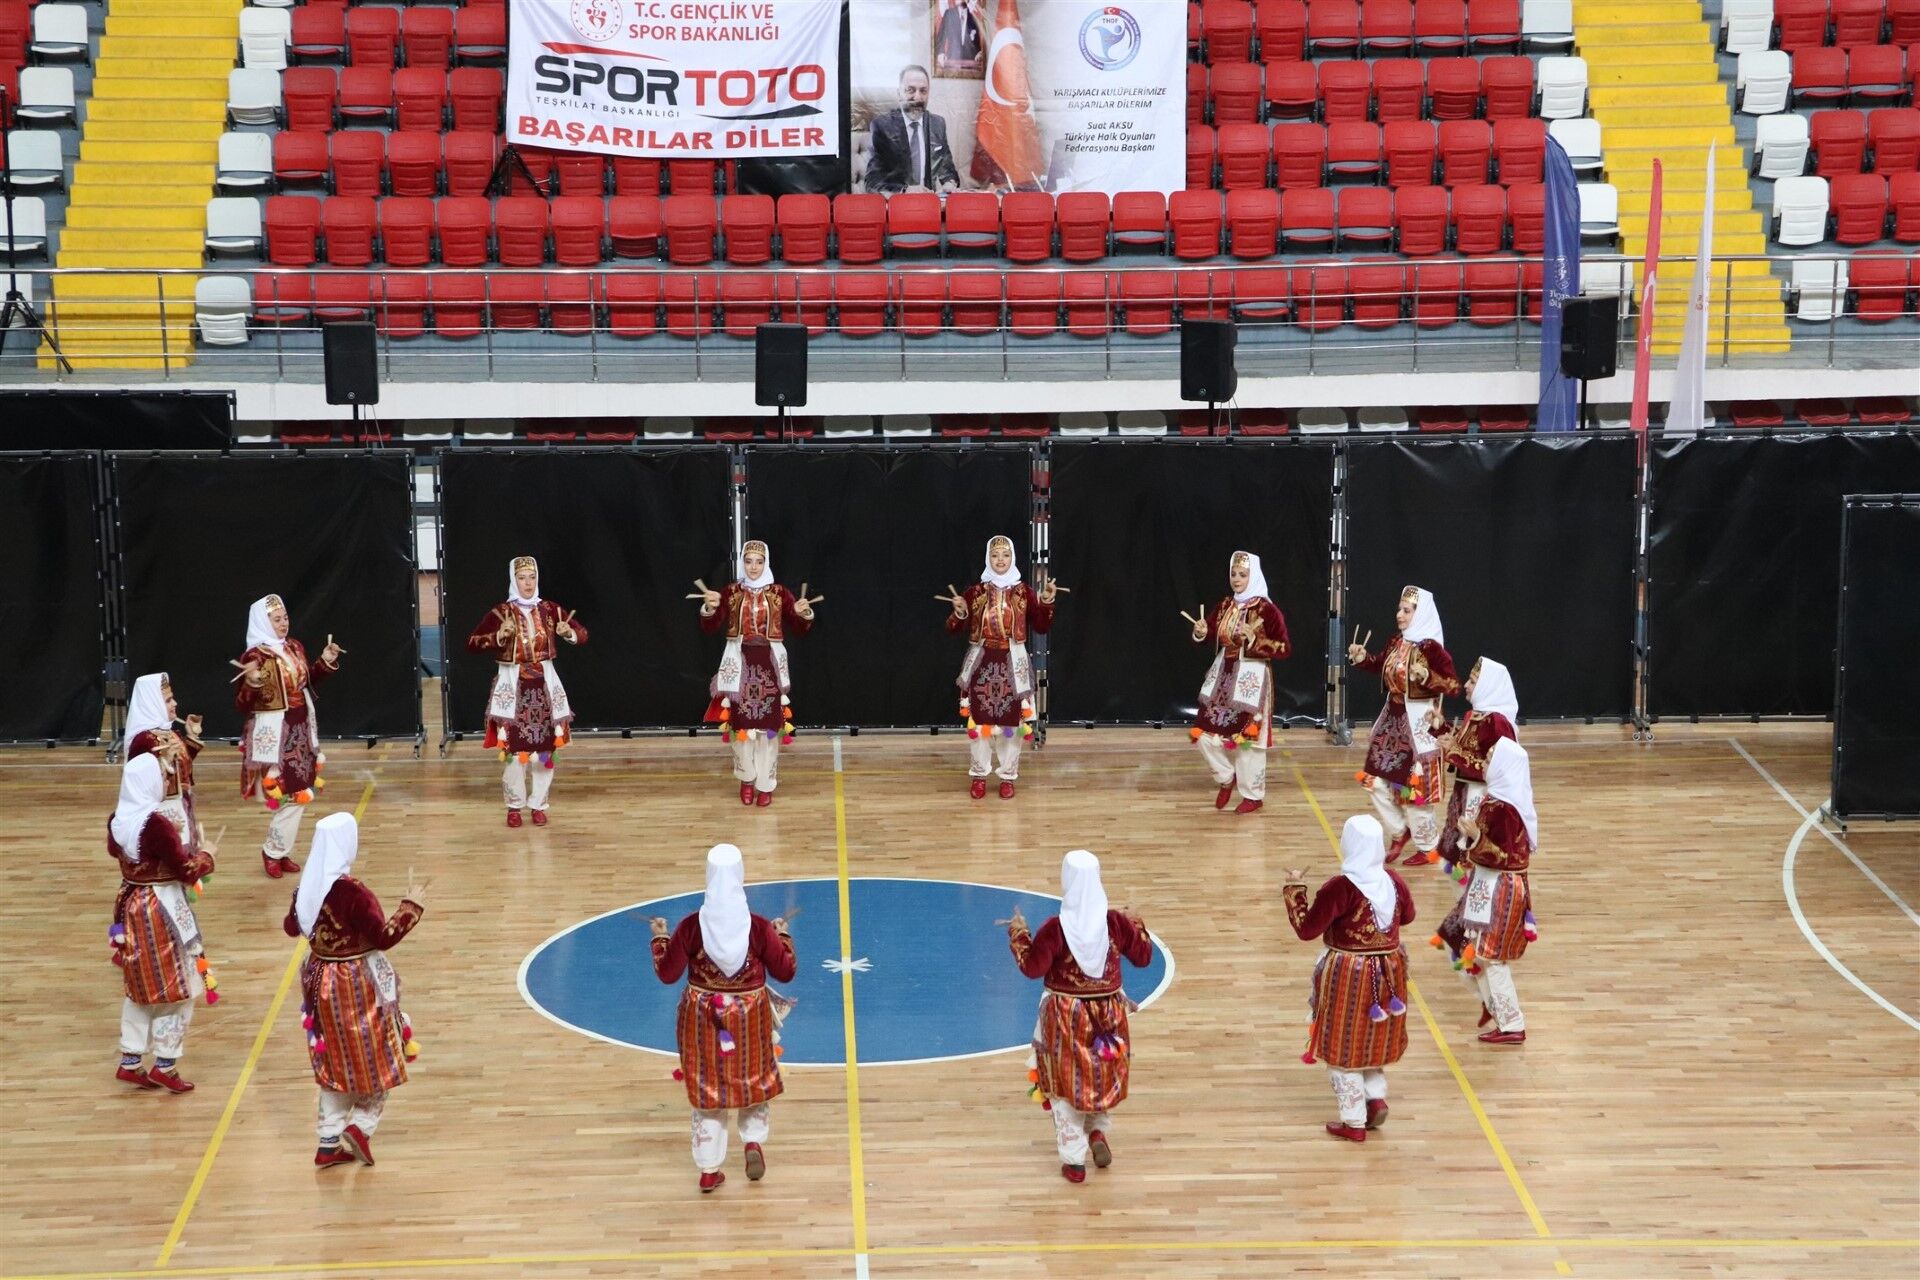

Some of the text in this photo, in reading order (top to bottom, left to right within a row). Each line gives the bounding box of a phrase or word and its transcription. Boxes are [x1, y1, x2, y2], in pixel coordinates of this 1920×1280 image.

[634, 2, 774, 24] T.C. GENÇLİK VE
[629, 22, 779, 42] SPOR BAKANLIĞI
[534, 54, 826, 107] SPOR TOTO
[1053, 86, 1167, 98] YARIŞMACI KULÜPLERİMİZE
[535, 96, 680, 119] TEŞKİLAT BAŞKANLIĞI
[1067, 100, 1115, 110] BAŞARILAR
[517, 115, 826, 150] BAŞARILAR DİLER
[1087, 121, 1134, 130] Suat AKSU
[1064, 132, 1156, 142] Türkiye Halk Oyunları
[1064, 143, 1155, 154] Federasyonu Başkanı
